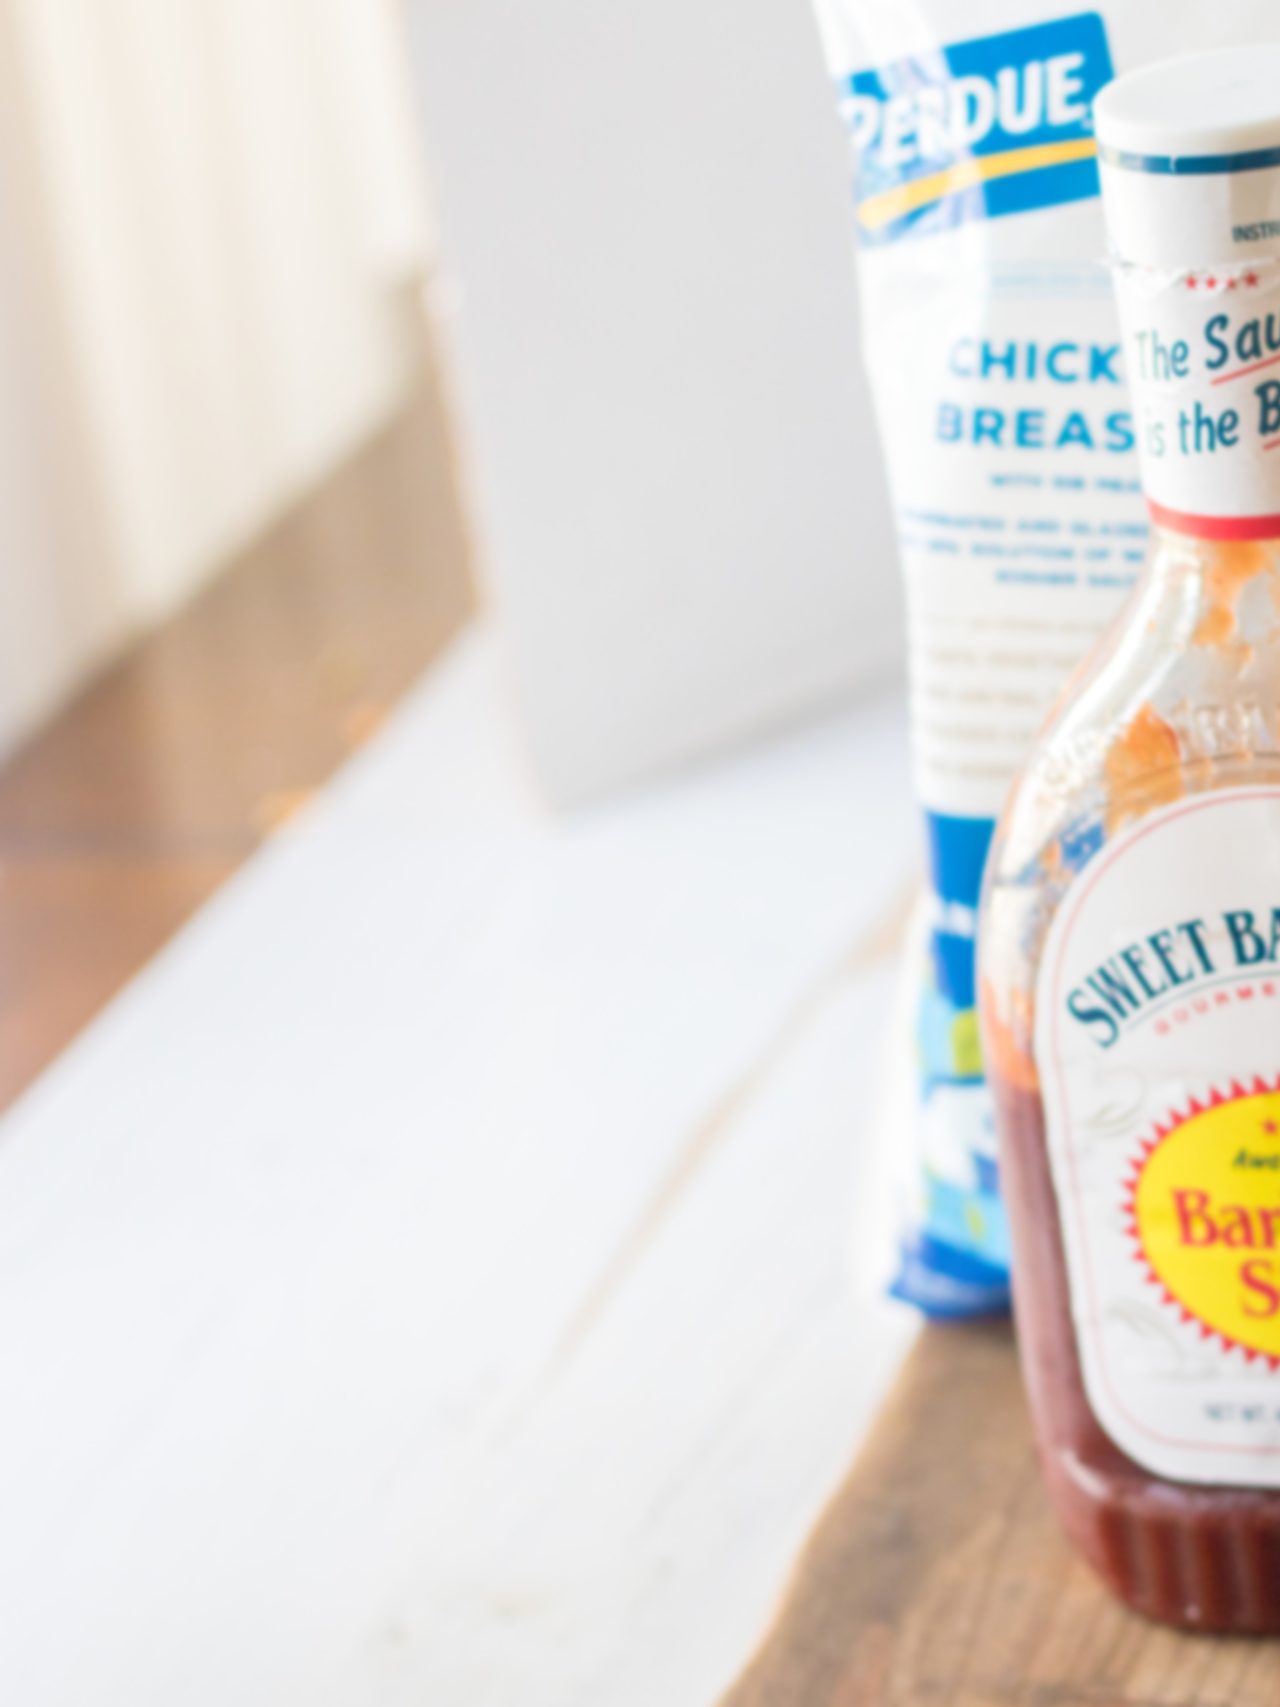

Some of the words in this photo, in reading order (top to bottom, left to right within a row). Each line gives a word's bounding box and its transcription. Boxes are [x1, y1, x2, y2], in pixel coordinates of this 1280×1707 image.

[1134, 328, 1190, 382] The
[1179, 399, 1241, 456] the
[1066, 918, 1217, 1050] SWEET
